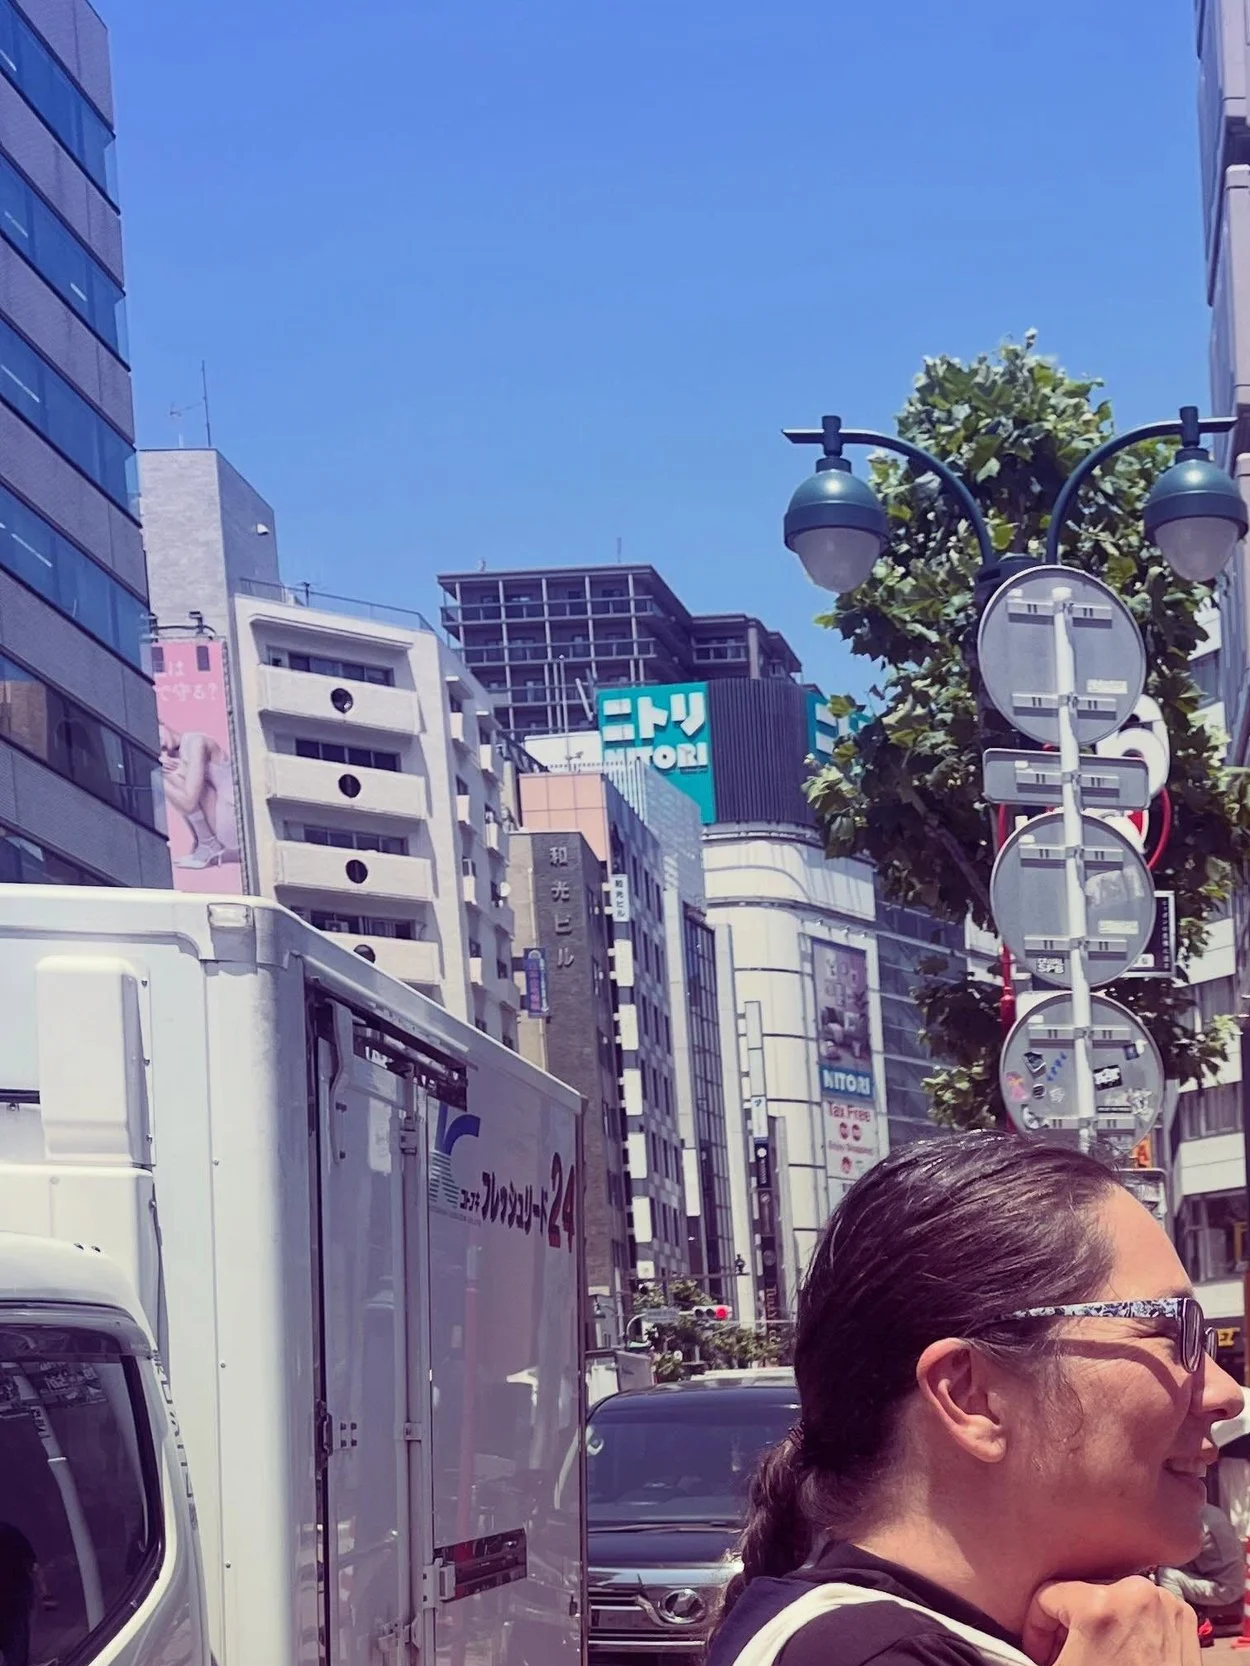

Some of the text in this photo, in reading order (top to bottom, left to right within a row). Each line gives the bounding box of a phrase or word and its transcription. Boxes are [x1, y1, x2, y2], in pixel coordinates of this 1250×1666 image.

[602, 692, 706, 742] ニトリ
[604, 742, 708, 770] NITORI
[550, 846, 575, 969] 和光ビル
[823, 1069, 870, 1096] NITORI
[847, 1104, 871, 1122] Free
